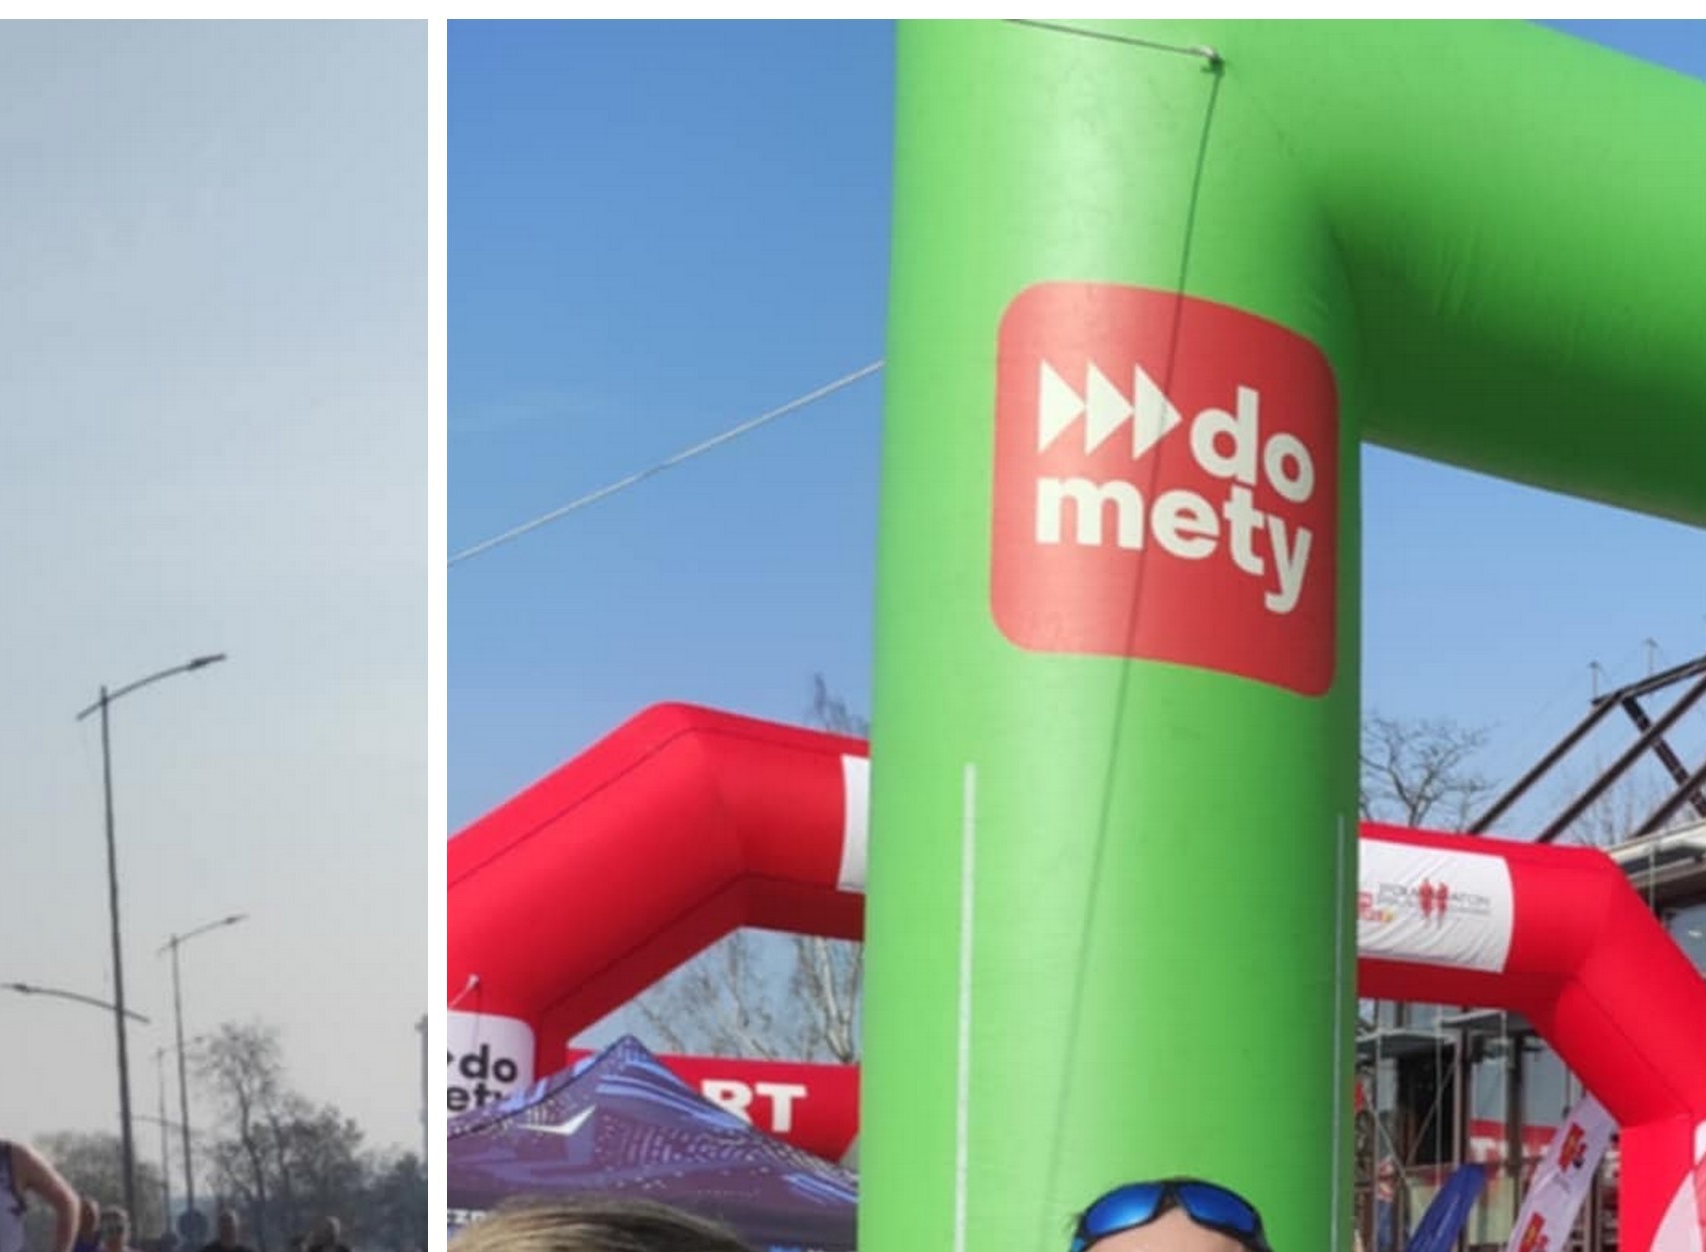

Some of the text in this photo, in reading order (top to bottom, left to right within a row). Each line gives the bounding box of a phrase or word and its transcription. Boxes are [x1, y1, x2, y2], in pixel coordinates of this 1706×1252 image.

[1190, 385, 1315, 503] do
[1035, 477, 1313, 614] mety
[459, 1042, 518, 1083] do
[701, 1079, 807, 1133] RT
